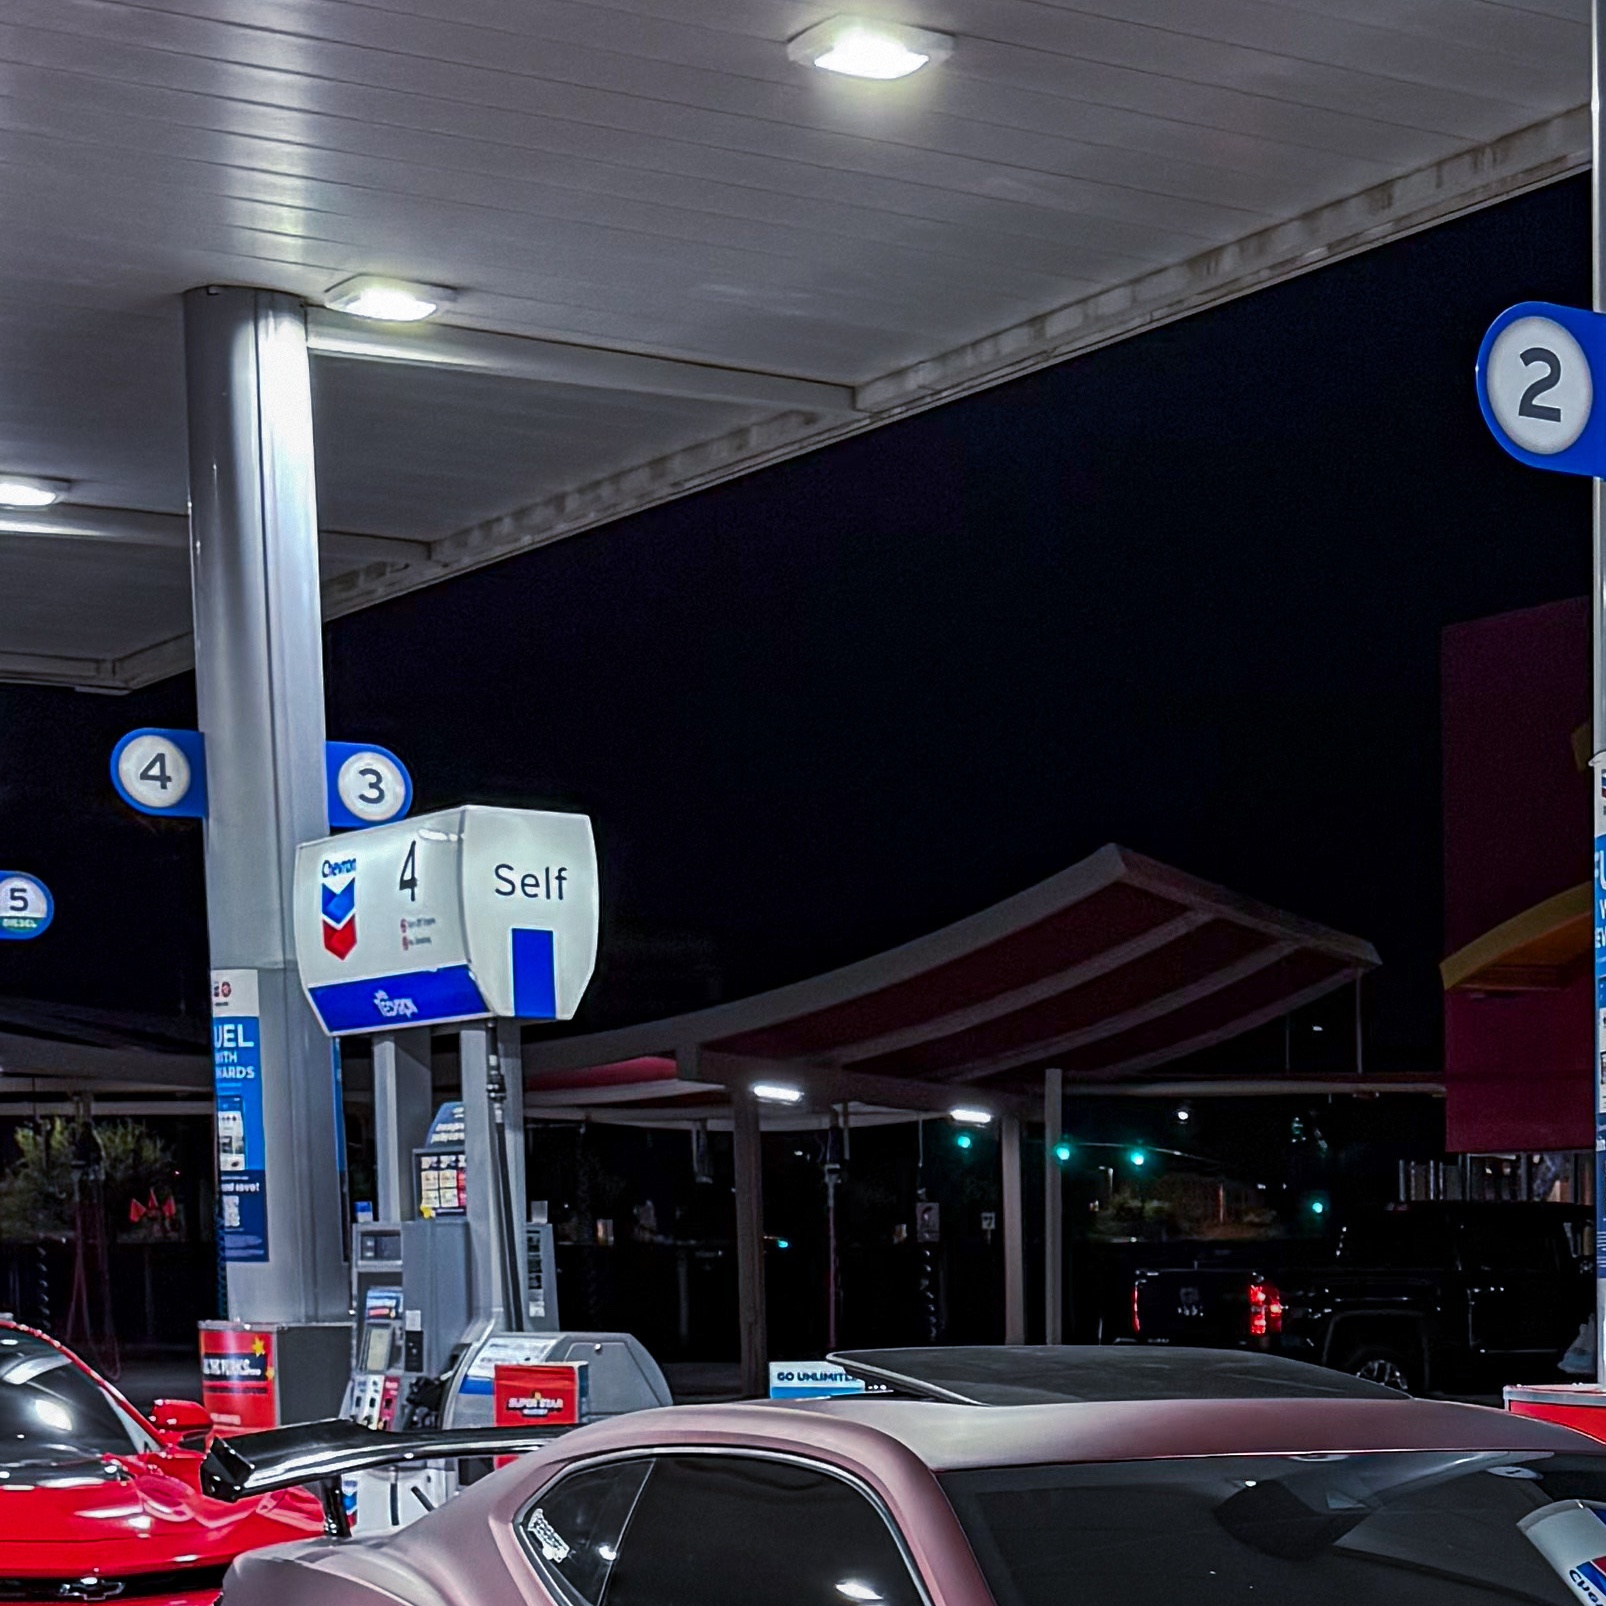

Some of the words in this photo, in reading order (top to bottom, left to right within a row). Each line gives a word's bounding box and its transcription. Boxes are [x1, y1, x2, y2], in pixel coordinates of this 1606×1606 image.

[1518, 347, 1562, 423] 2
[139, 752, 173, 790] 4
[357, 768, 385, 804] 3
[322, 858, 356, 878] Chevron
[399, 840, 418, 902] 4
[494, 863, 568, 901] Self
[10, 888, 28, 911] 5
[777, 1372, 794, 1380] GO
